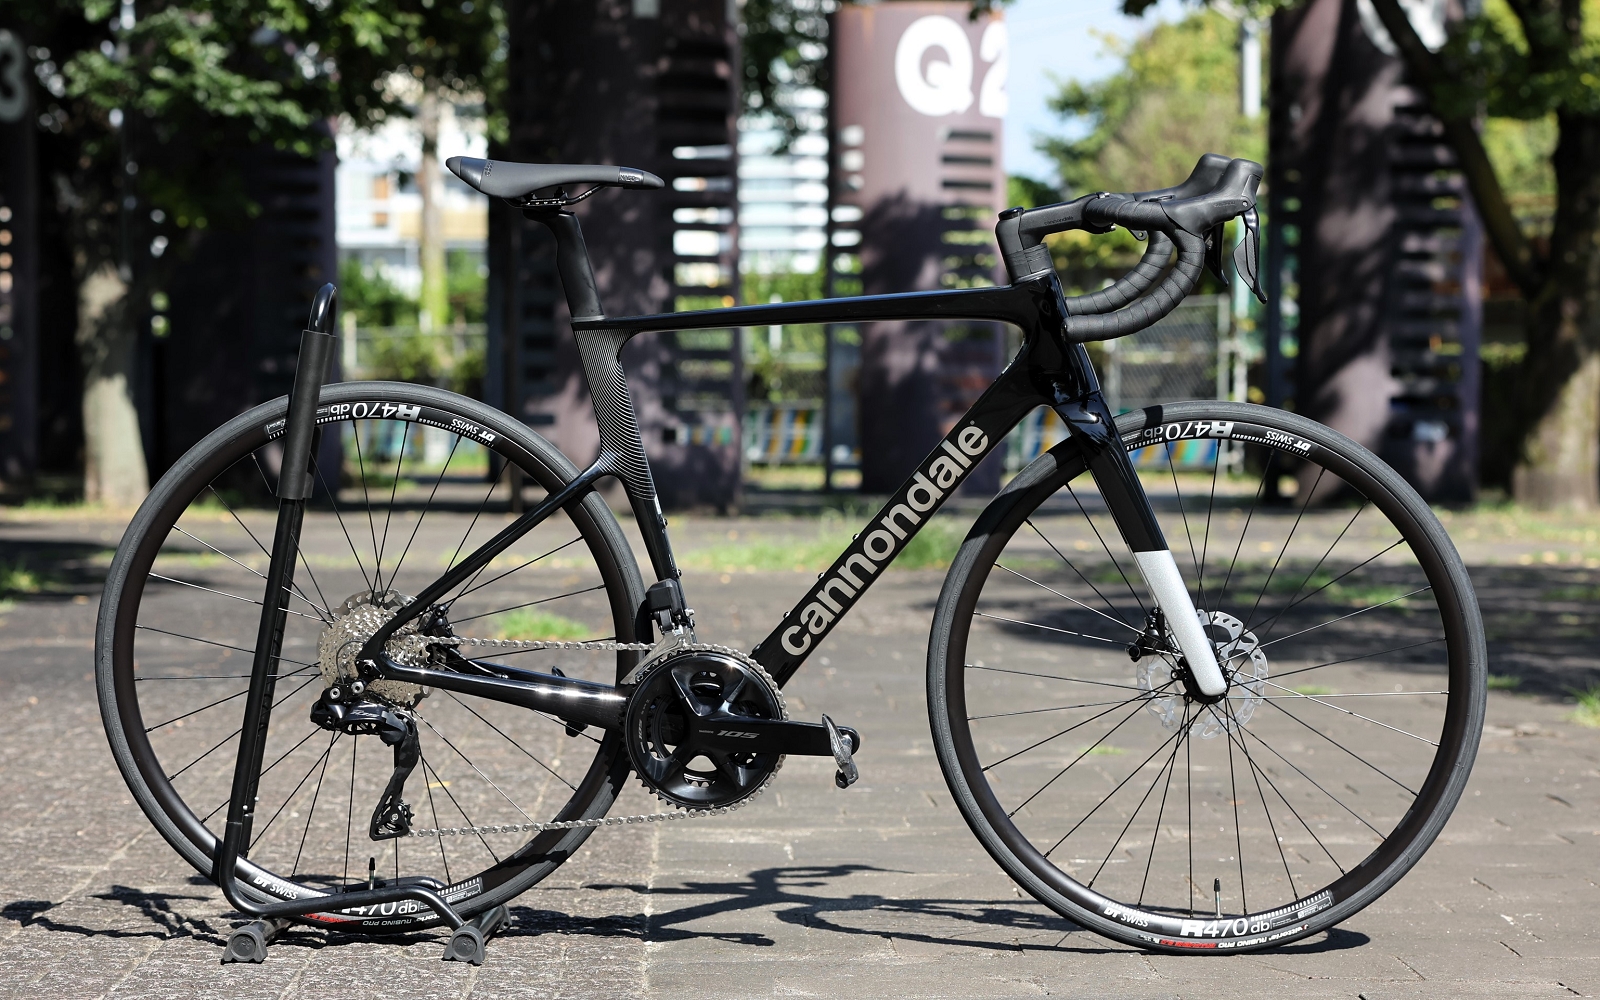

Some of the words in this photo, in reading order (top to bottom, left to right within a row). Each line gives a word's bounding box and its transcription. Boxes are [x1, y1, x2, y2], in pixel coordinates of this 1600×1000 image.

[330, 403, 350, 414] db
[352, 402, 422, 421] R470
[450, 418, 479, 434] SWISS
[1143, 426, 1163, 438] db
[1165, 421, 1234, 440] R470
[478, 432, 496, 442] DT
[1265, 430, 1294, 445] SWISS
[1293, 439, 1312, 451] DT
[781, 425, 989, 656] cannondale
[717, 730, 760, 739] 105
[253, 875, 271, 887] DT
[270, 883, 299, 899] SWISS
[397, 902, 418, 914] db
[1103, 906, 1121, 918] DT
[1120, 913, 1149, 927] SWISS
[1180, 917, 1248, 938] R470
[1250, 920, 1270, 934] db
[1236, 936, 1267, 946] RUBINO
